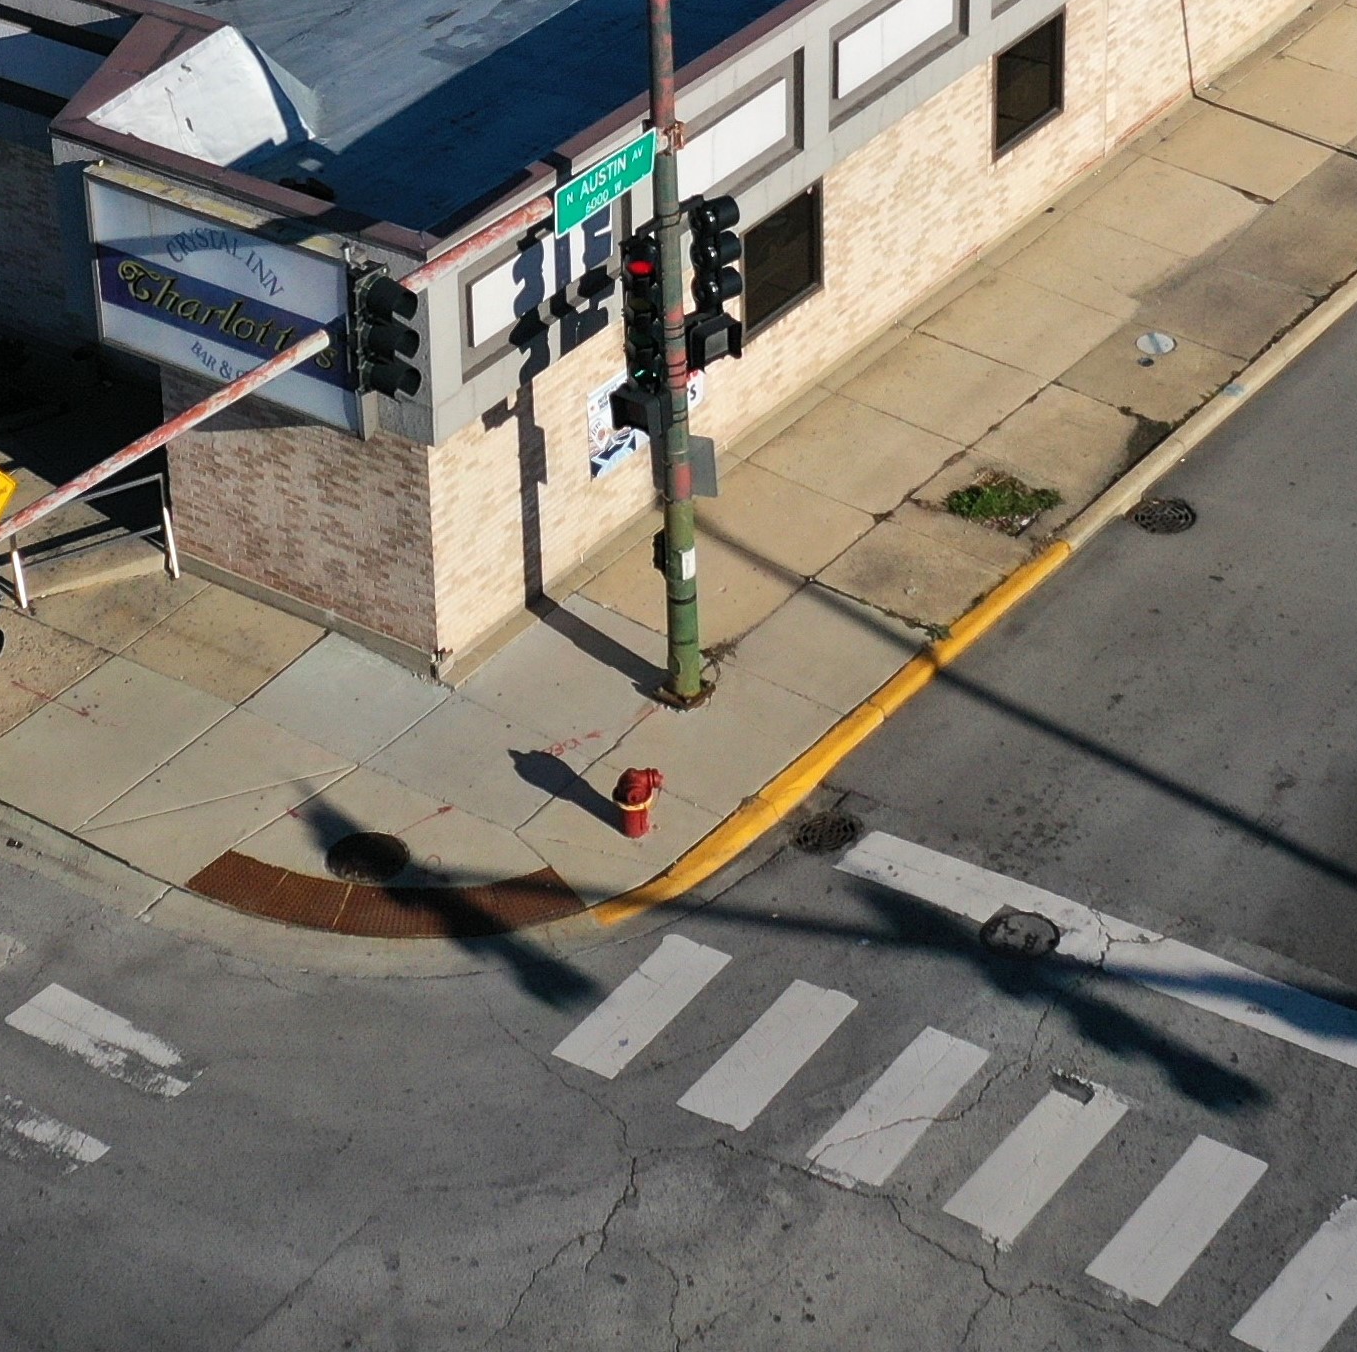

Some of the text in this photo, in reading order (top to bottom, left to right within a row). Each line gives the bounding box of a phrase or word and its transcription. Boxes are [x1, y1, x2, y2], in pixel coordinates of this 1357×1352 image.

[566, 145, 644, 206] N AUSTIN AV
[585, 179, 622, 214] 6000 W
[166, 227, 284, 297] CRYSTAL INN
[118, 259, 338, 369] Charlotts
[190, 341, 233, 380] BAR &
